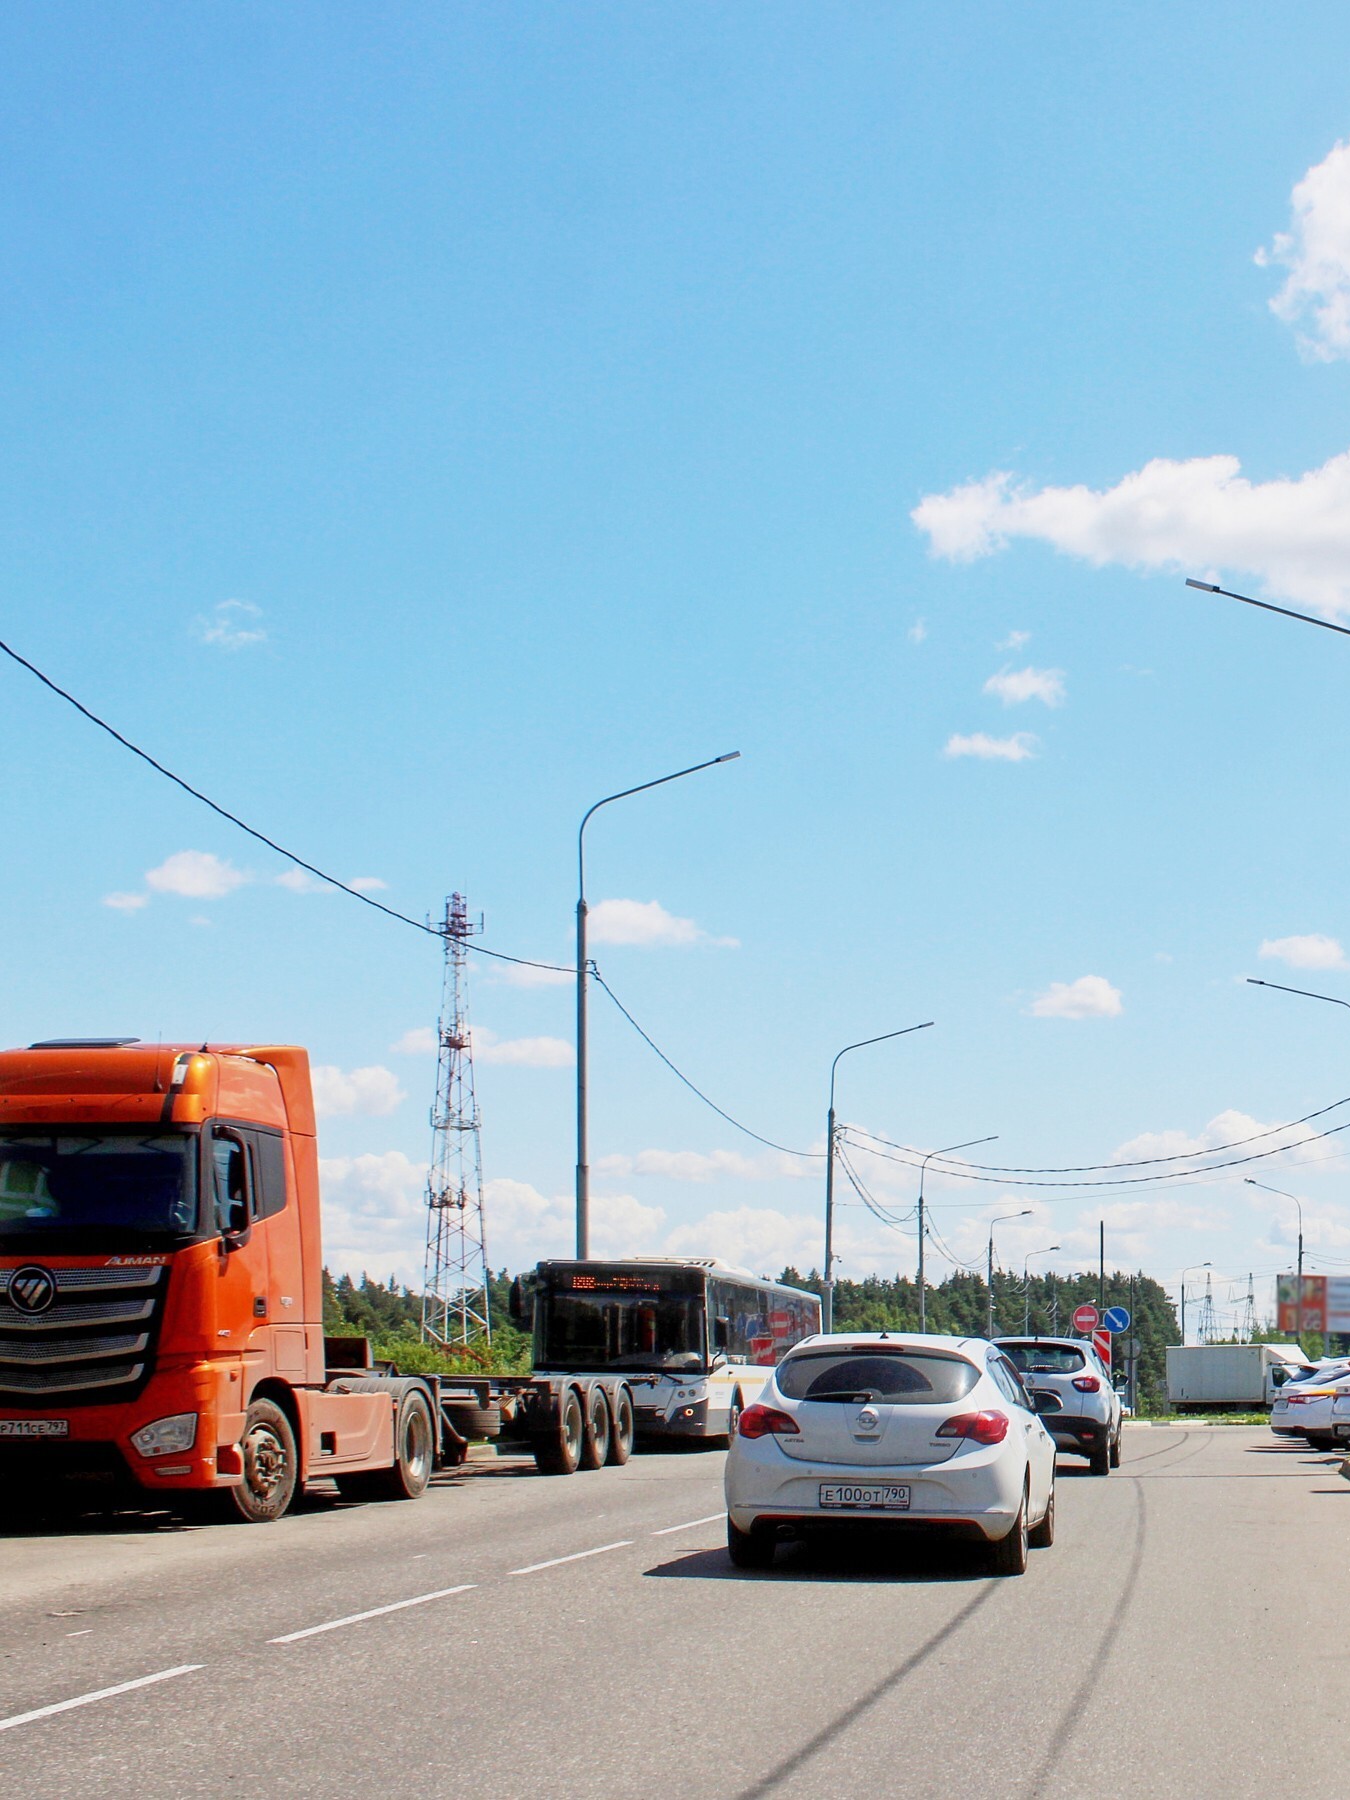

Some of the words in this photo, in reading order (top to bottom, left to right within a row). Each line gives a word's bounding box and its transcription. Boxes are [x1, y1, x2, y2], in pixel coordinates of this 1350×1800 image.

[104, 1255, 166, 1266] AUMAN
[47, 1421, 65, 1430] 797
[884, 1487, 906, 1499] 790
